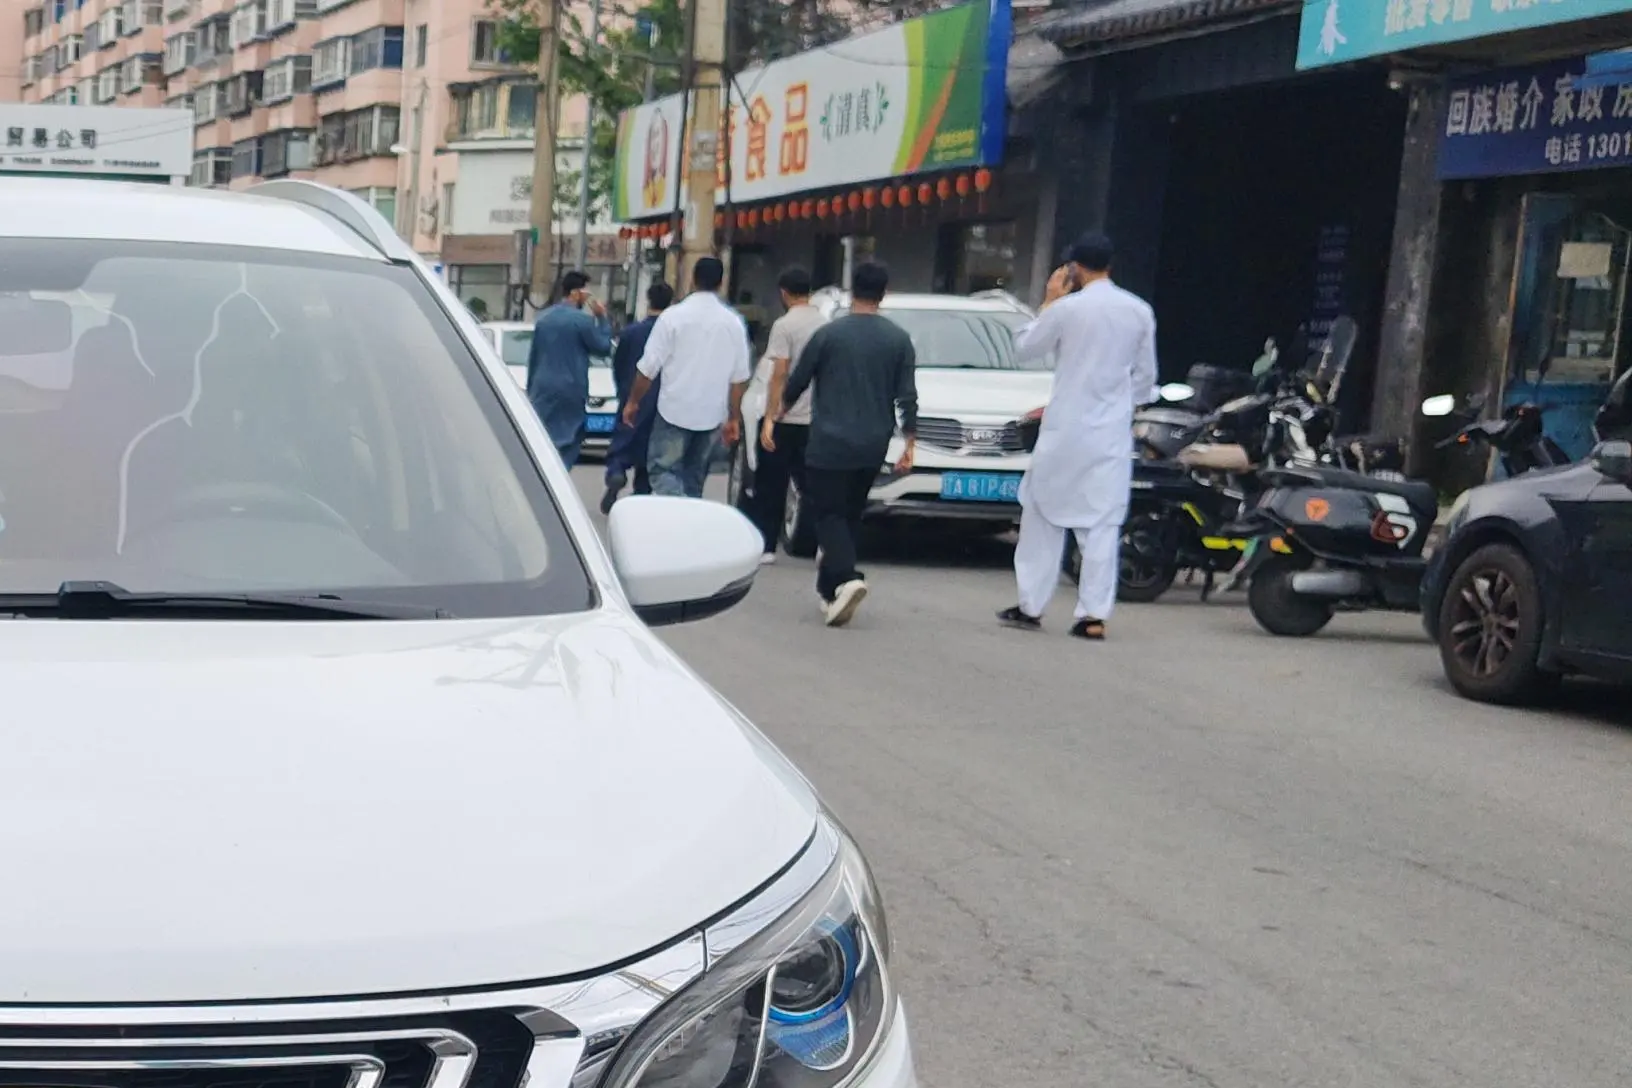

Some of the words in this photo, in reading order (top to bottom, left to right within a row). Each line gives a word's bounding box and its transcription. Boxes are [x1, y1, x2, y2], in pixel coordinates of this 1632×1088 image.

[1446, 76, 1544, 137] 回族婚介
[1545, 133, 1582, 165] 电话
